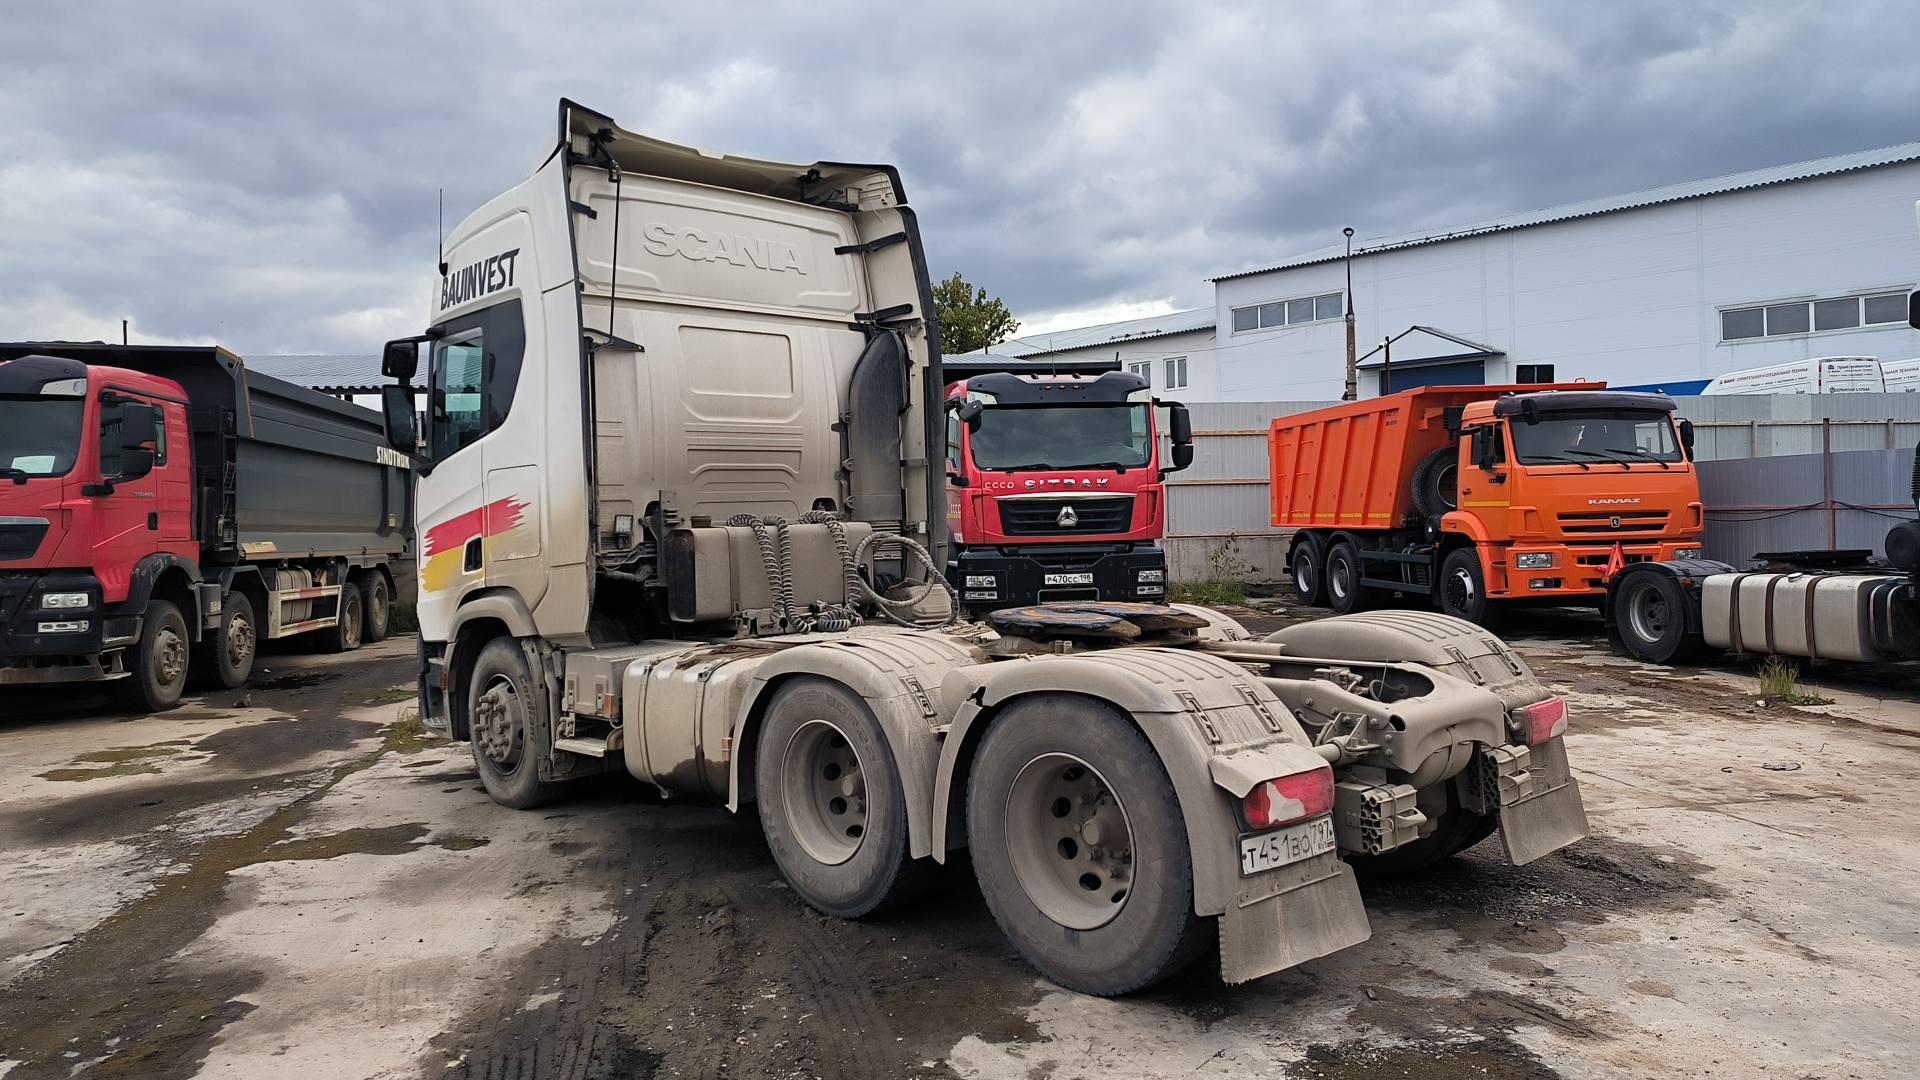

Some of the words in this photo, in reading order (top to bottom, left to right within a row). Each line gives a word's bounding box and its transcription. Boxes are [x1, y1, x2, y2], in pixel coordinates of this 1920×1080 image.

[643, 222, 807, 275] SCANIA
[440, 247, 521, 311] BAUINVEST
[1024, 478, 1110, 490] SITRAK
[1588, 497, 1641, 505] KAMAZ
